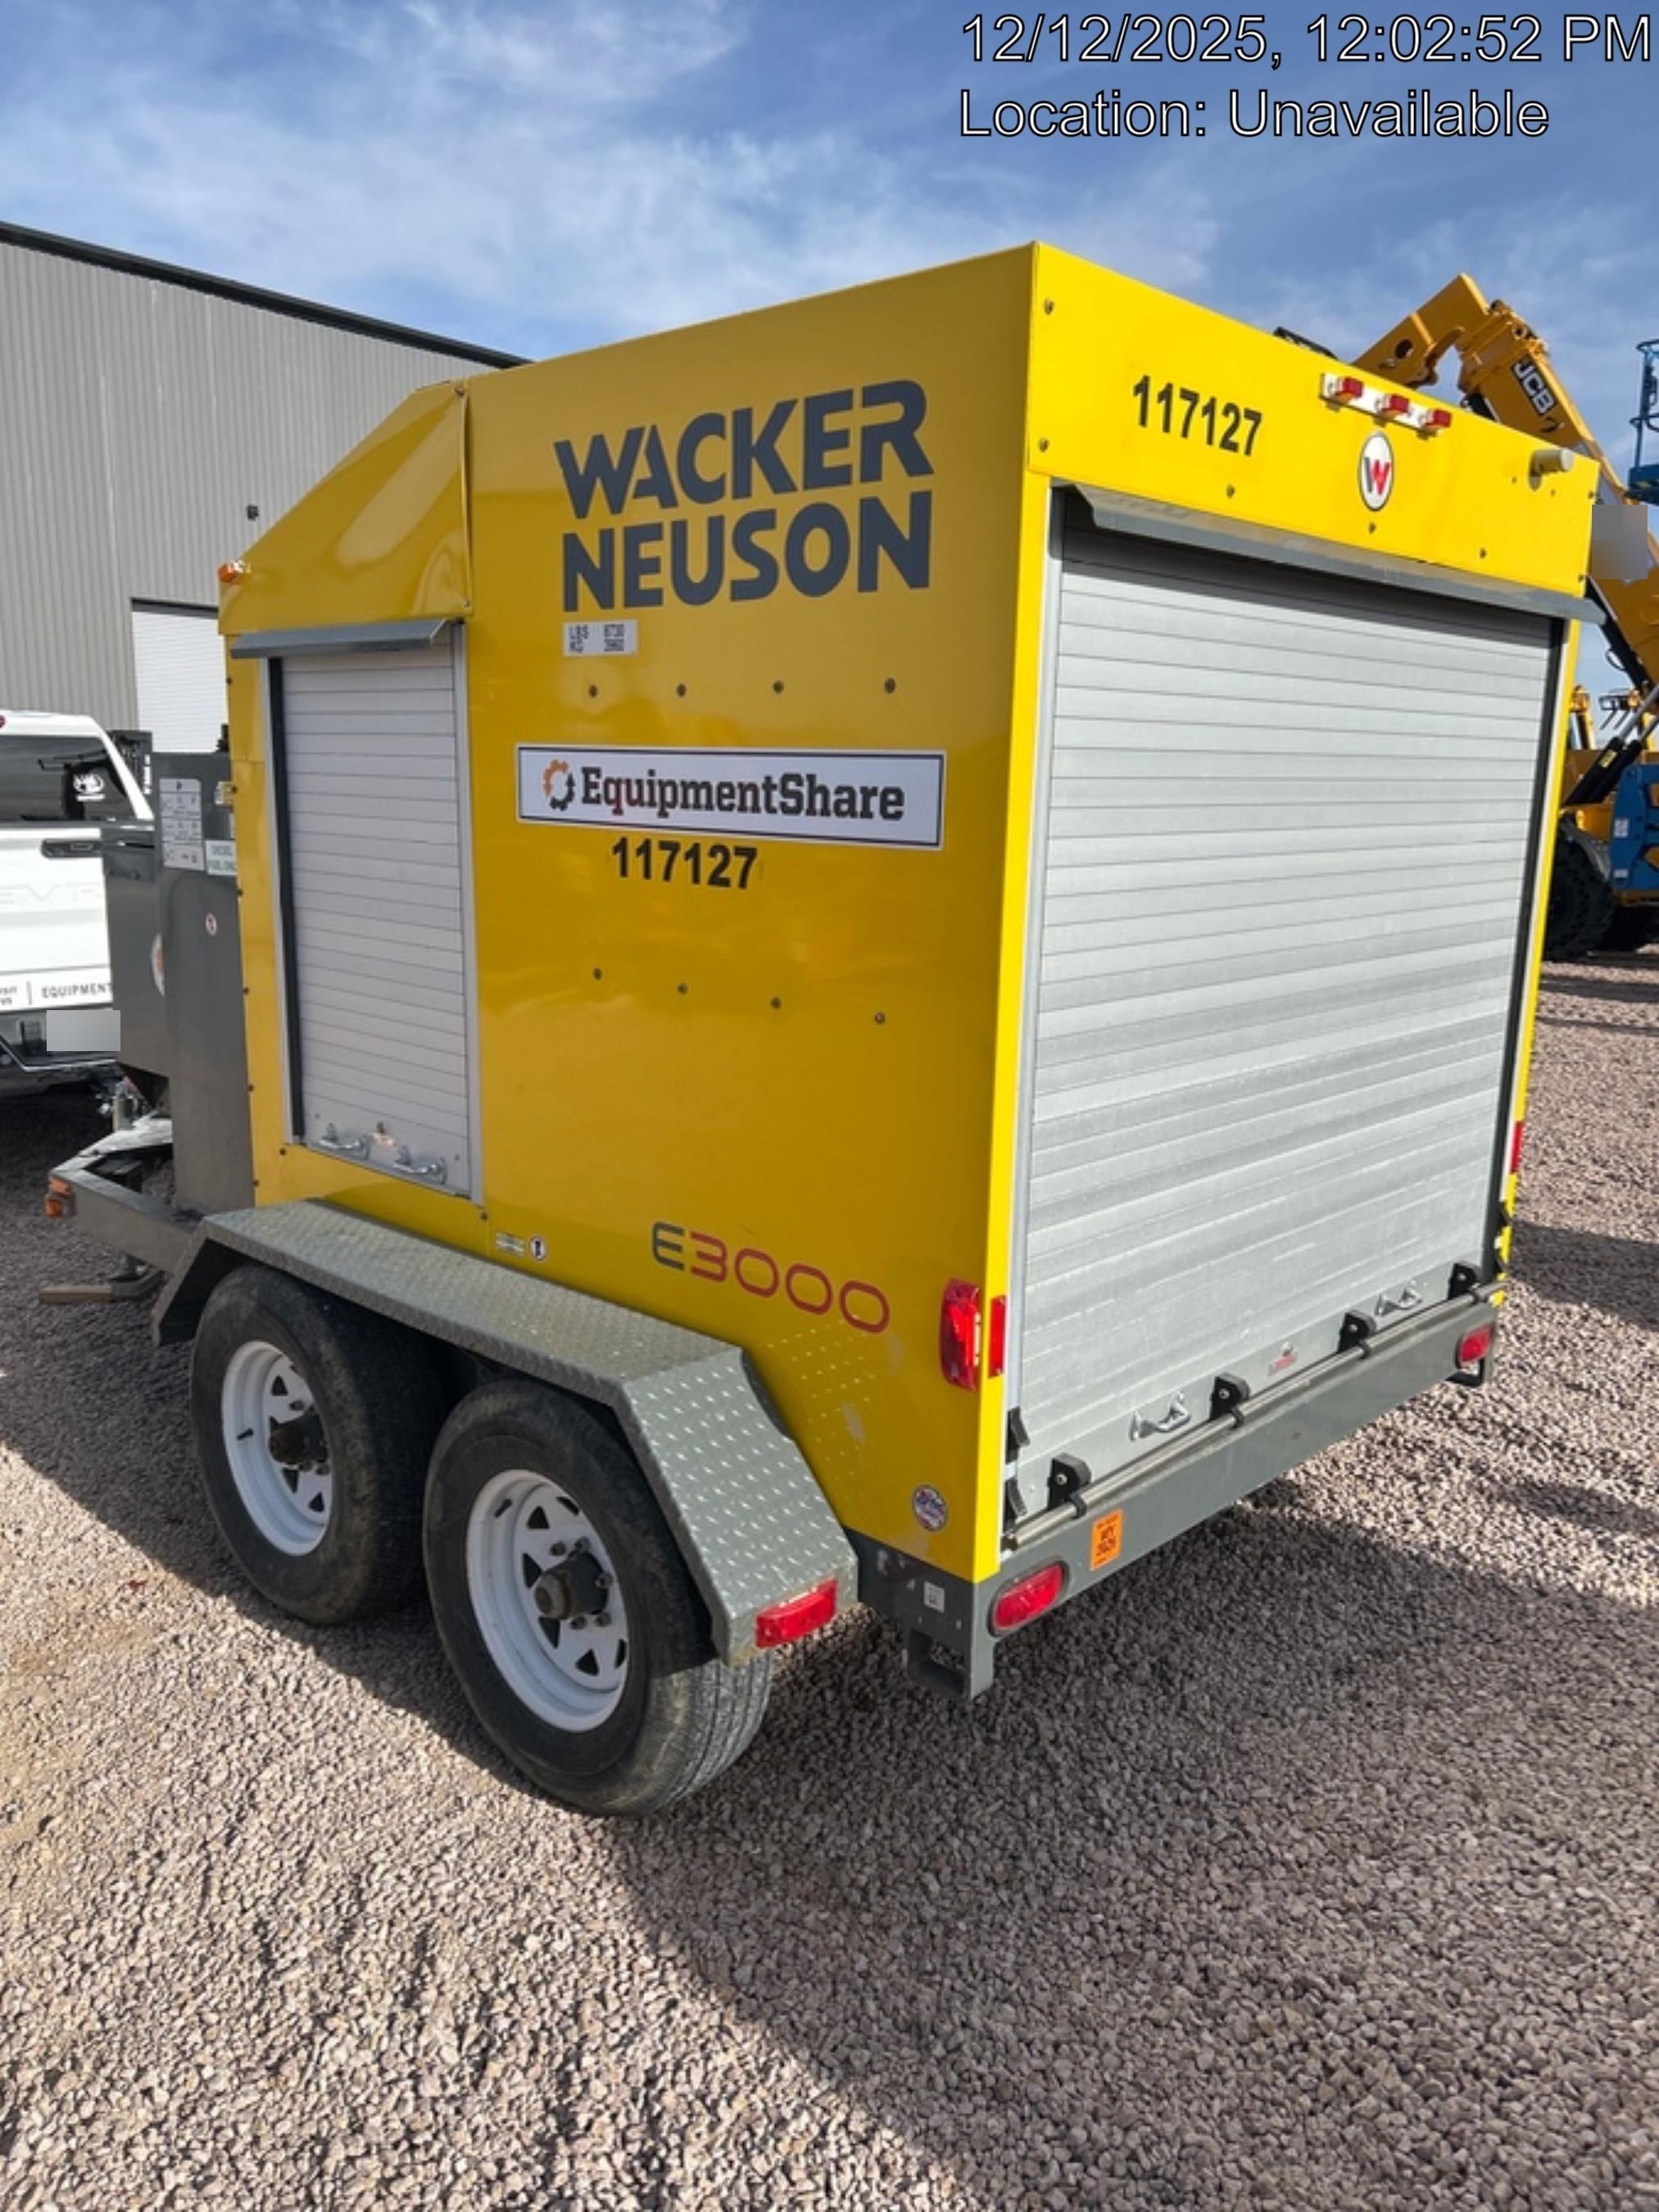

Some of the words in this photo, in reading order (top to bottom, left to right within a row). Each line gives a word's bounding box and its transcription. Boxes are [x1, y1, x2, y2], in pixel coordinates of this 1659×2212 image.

[1133, 374, 1262, 457] 117127
[1513, 362, 1555, 415] JCB
[553, 379, 935, 519] WACKER
[562, 489, 932, 613] NEUSON
[580, 765, 905, 821] EquipmentShare
[611, 836, 758, 890] 117127
[652, 1222, 891, 1334] E3000
